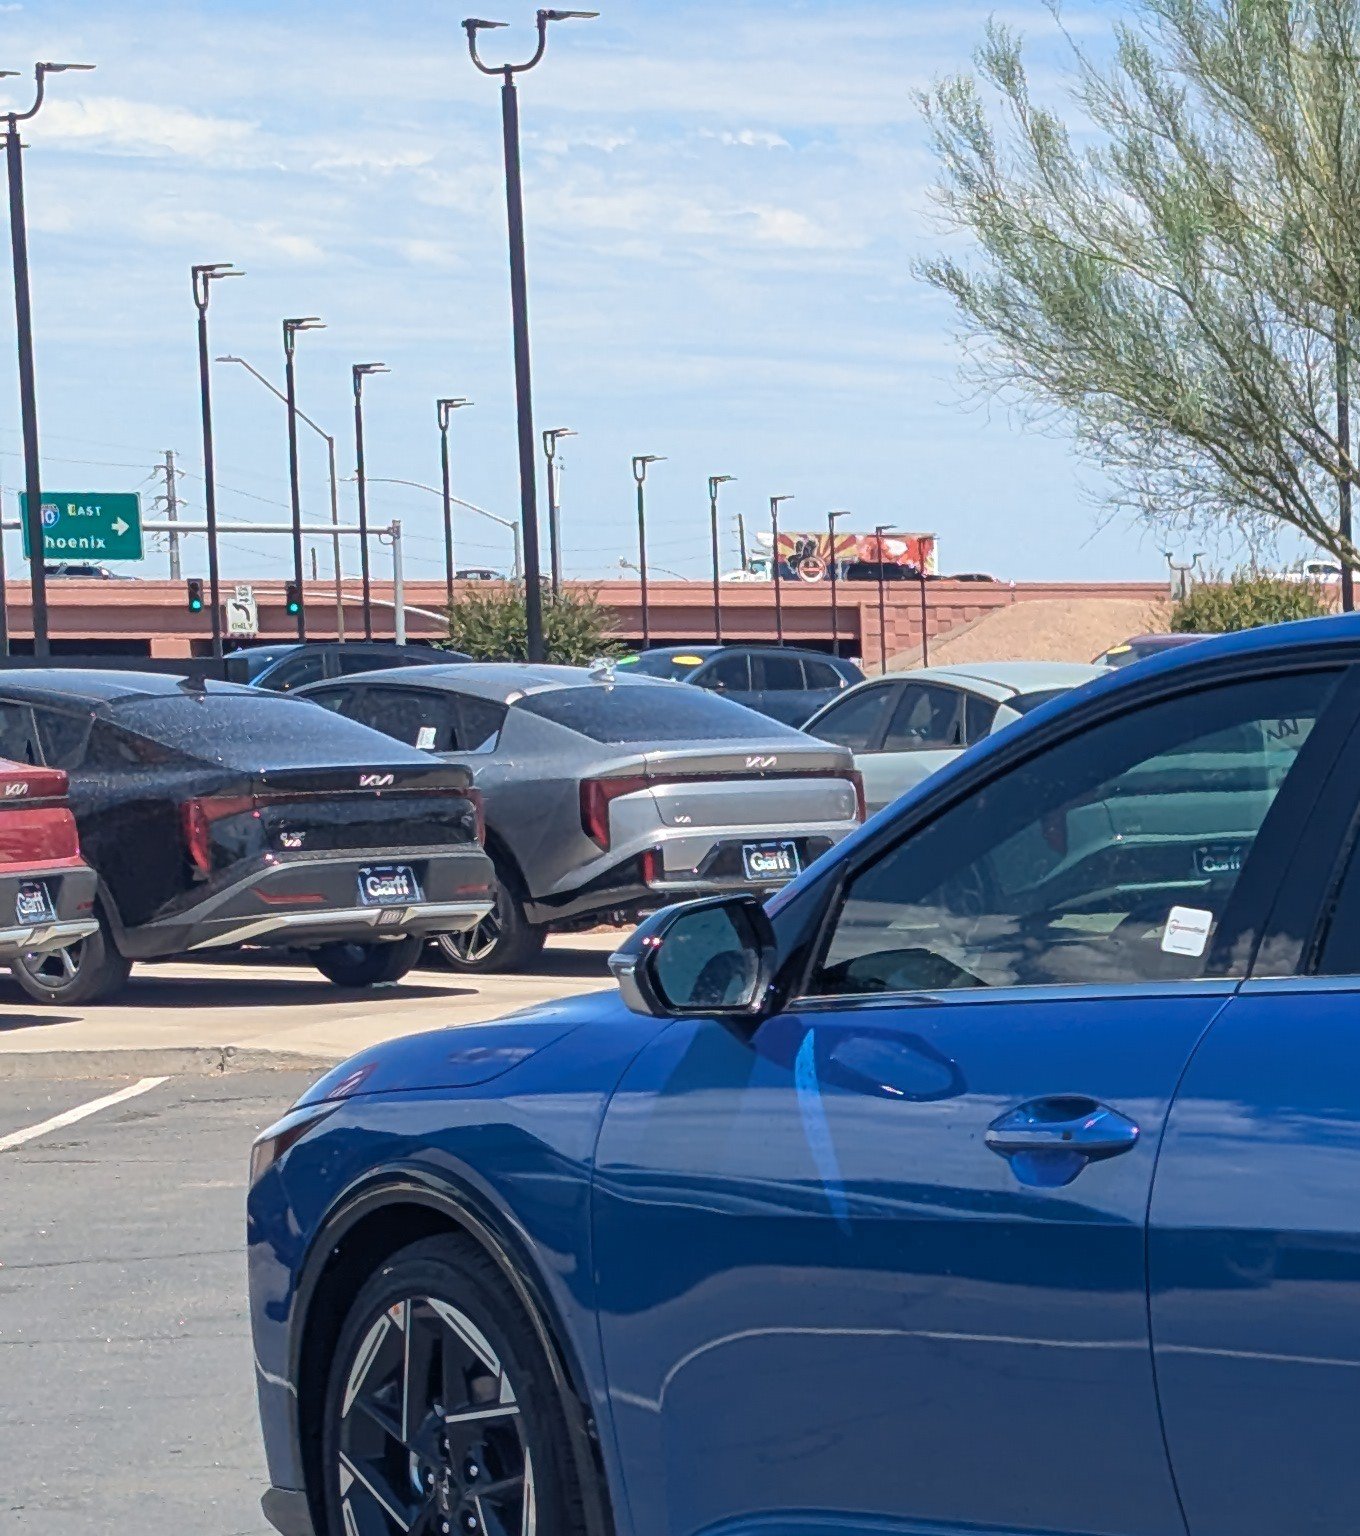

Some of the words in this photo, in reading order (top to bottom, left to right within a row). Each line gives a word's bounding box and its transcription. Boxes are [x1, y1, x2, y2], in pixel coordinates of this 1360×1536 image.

[44, 535, 106, 549] hoenix
[359, 774, 395, 787] KIA
[750, 851, 791, 871] Garff
[366, 874, 410, 897] Garff
